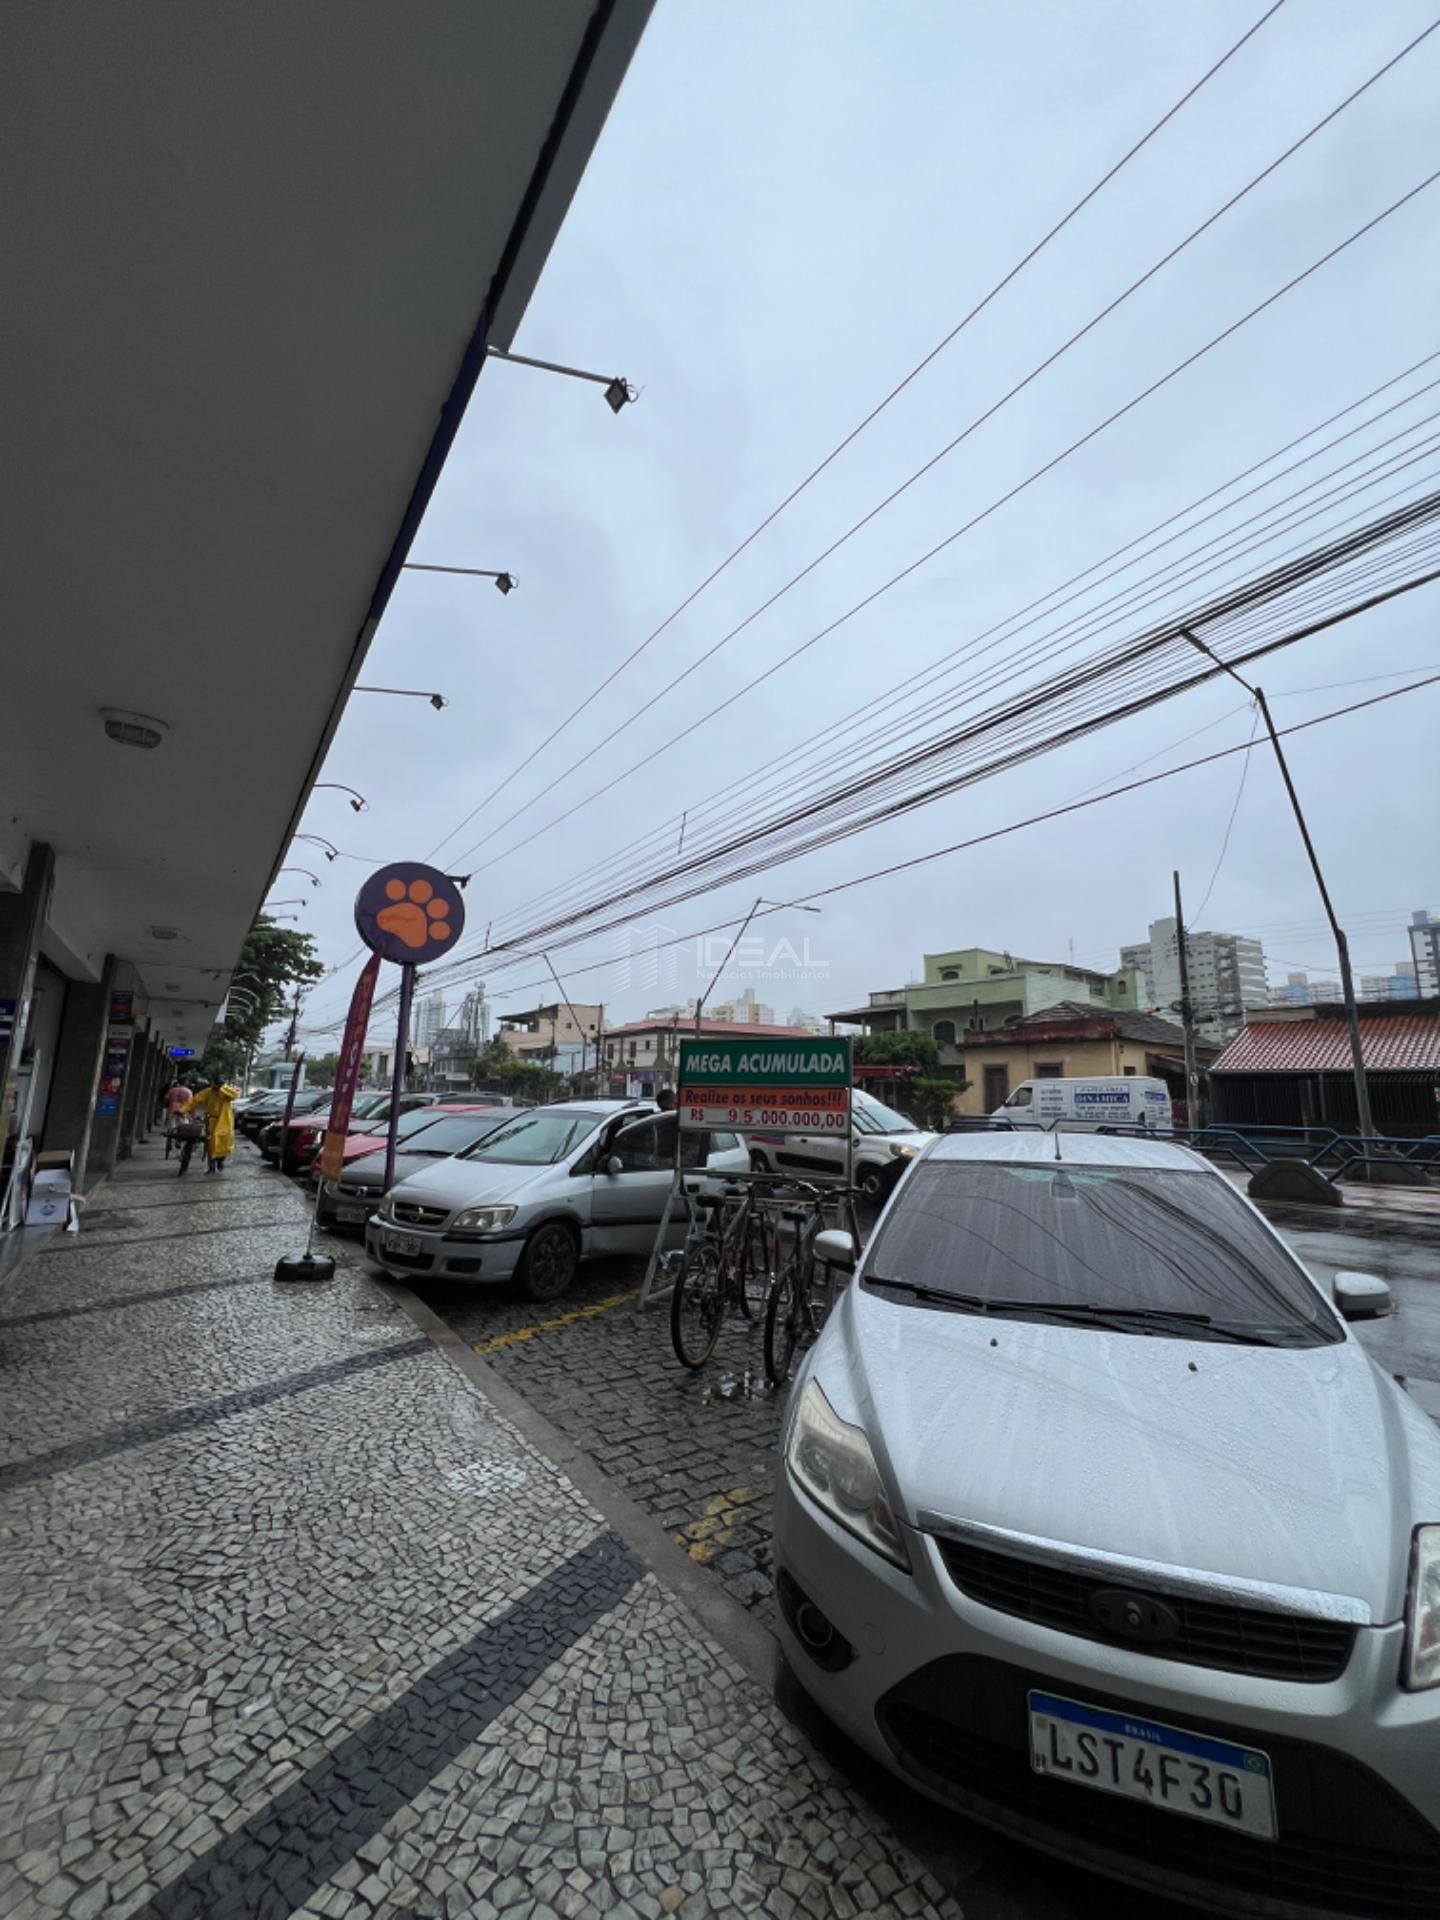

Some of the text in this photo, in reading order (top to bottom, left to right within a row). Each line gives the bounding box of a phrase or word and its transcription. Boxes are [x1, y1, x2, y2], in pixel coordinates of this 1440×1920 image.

[685, 1053, 845, 1073] MEGA ACUMULADA
[685, 1089, 842, 1108] Realize os seus sonhos!!!
[691, 1108, 704, 1121] R$
[1124, 1723, 1162, 1743] BRASIL
